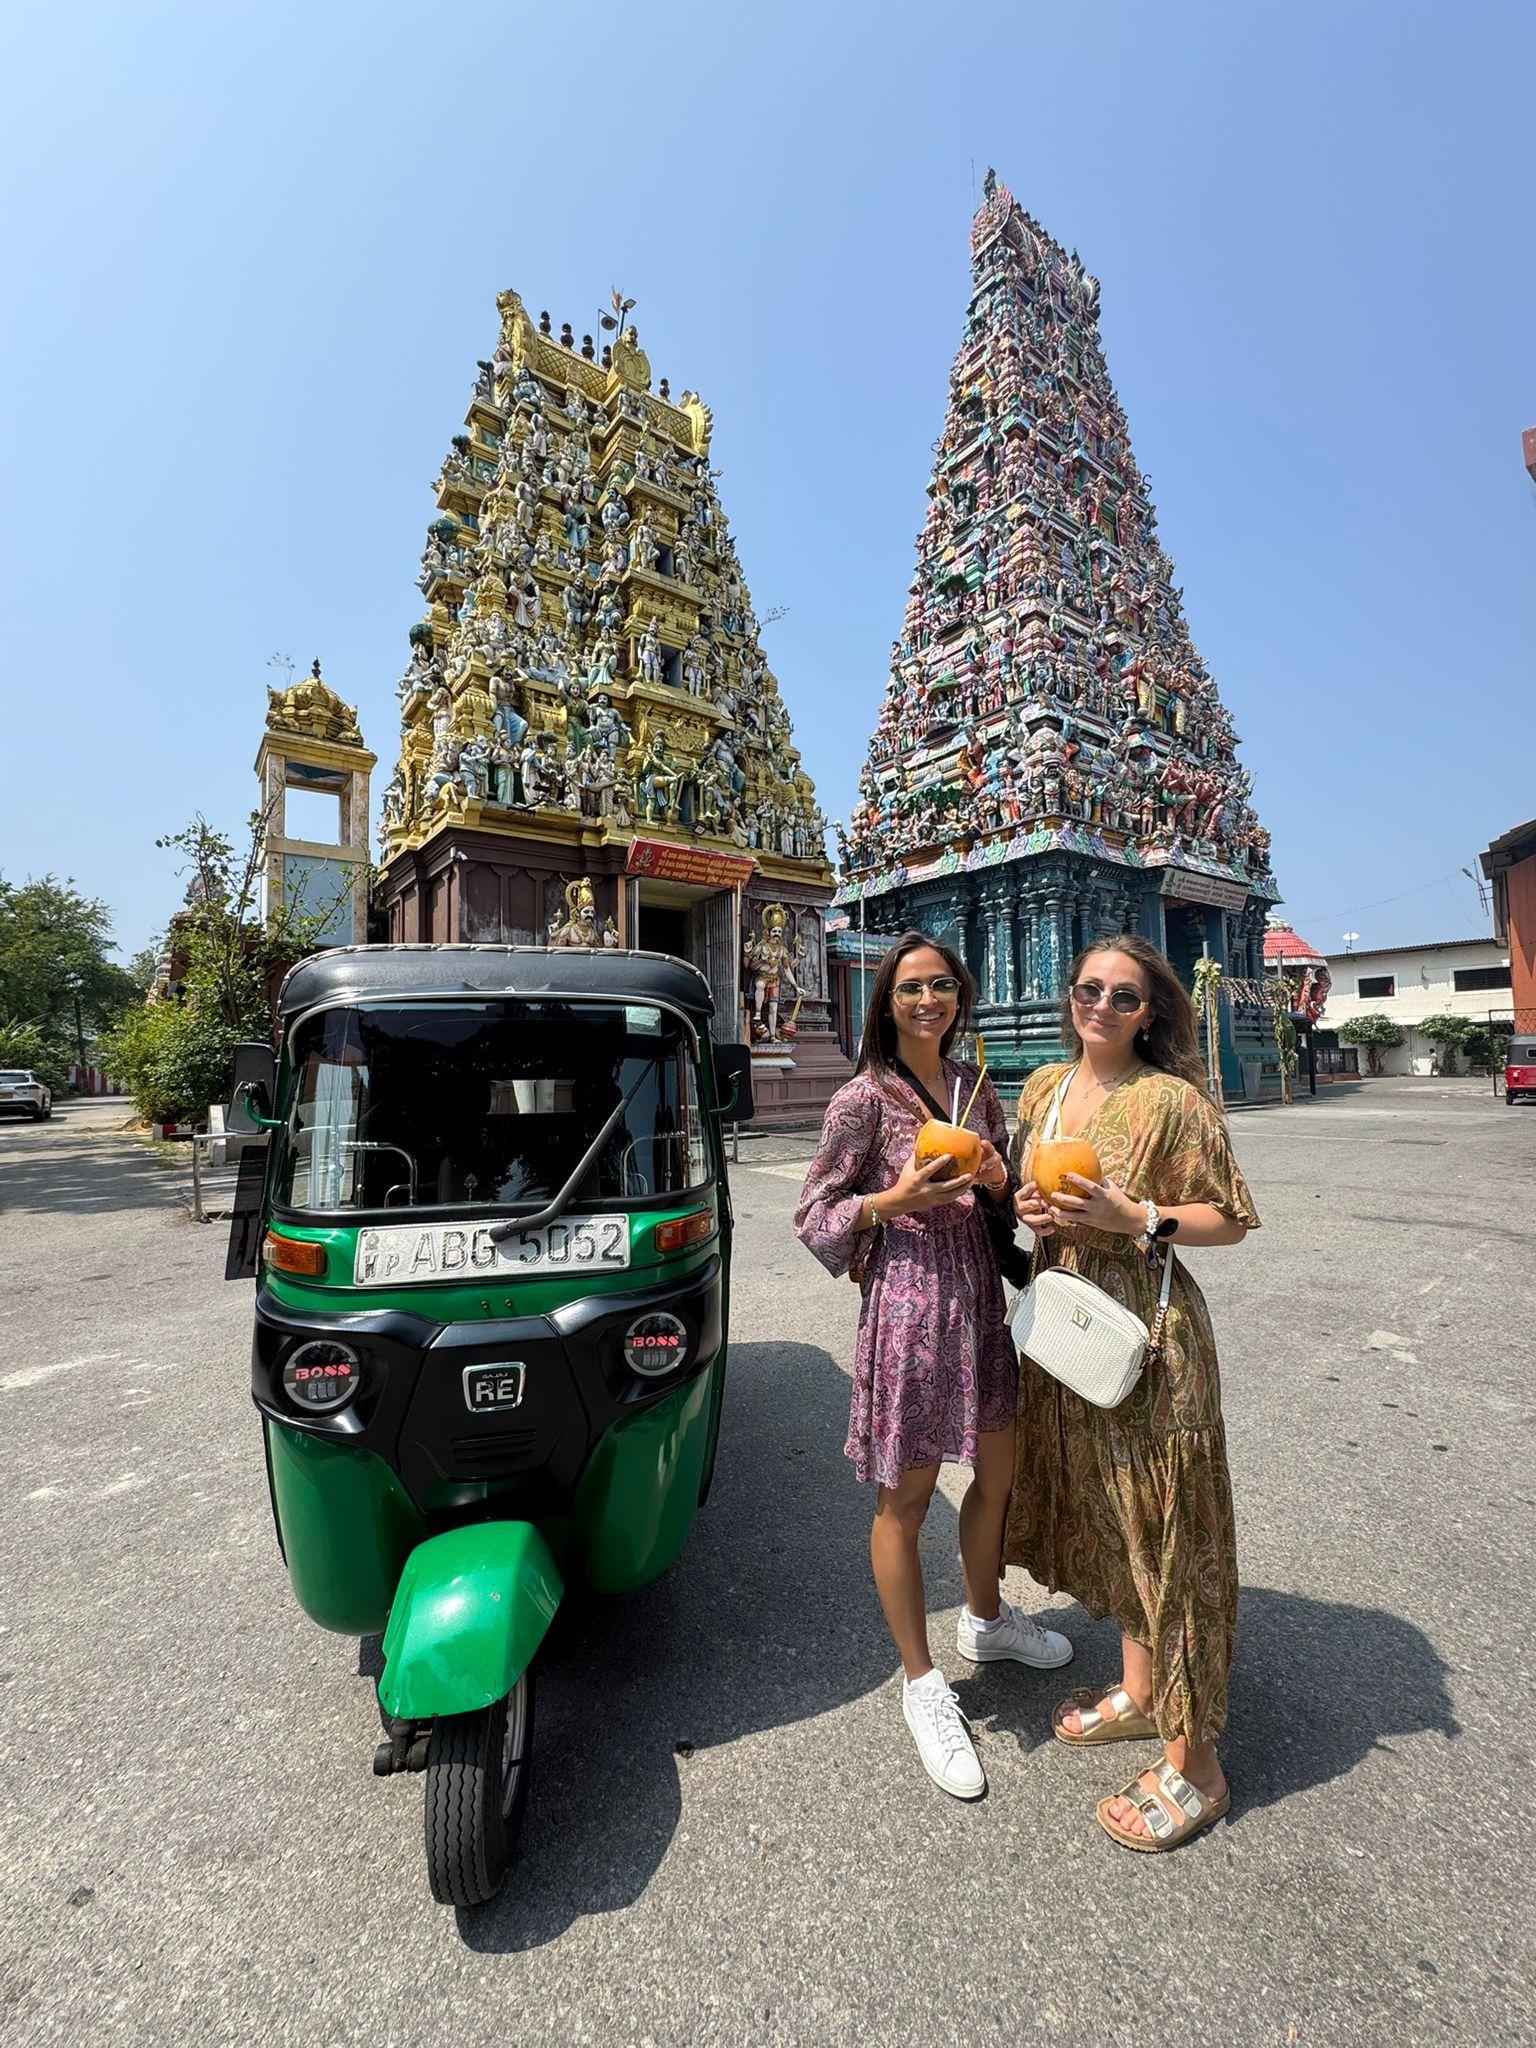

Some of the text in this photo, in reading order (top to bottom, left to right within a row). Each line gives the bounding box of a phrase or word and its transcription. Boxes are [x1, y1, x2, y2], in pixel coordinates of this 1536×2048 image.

[409, 1223, 625, 1274] ABG 5052
[632, 1335, 680, 1348] BOSS
[295, 1364, 351, 1380] BOSS
[475, 1379, 514, 1402] RE
